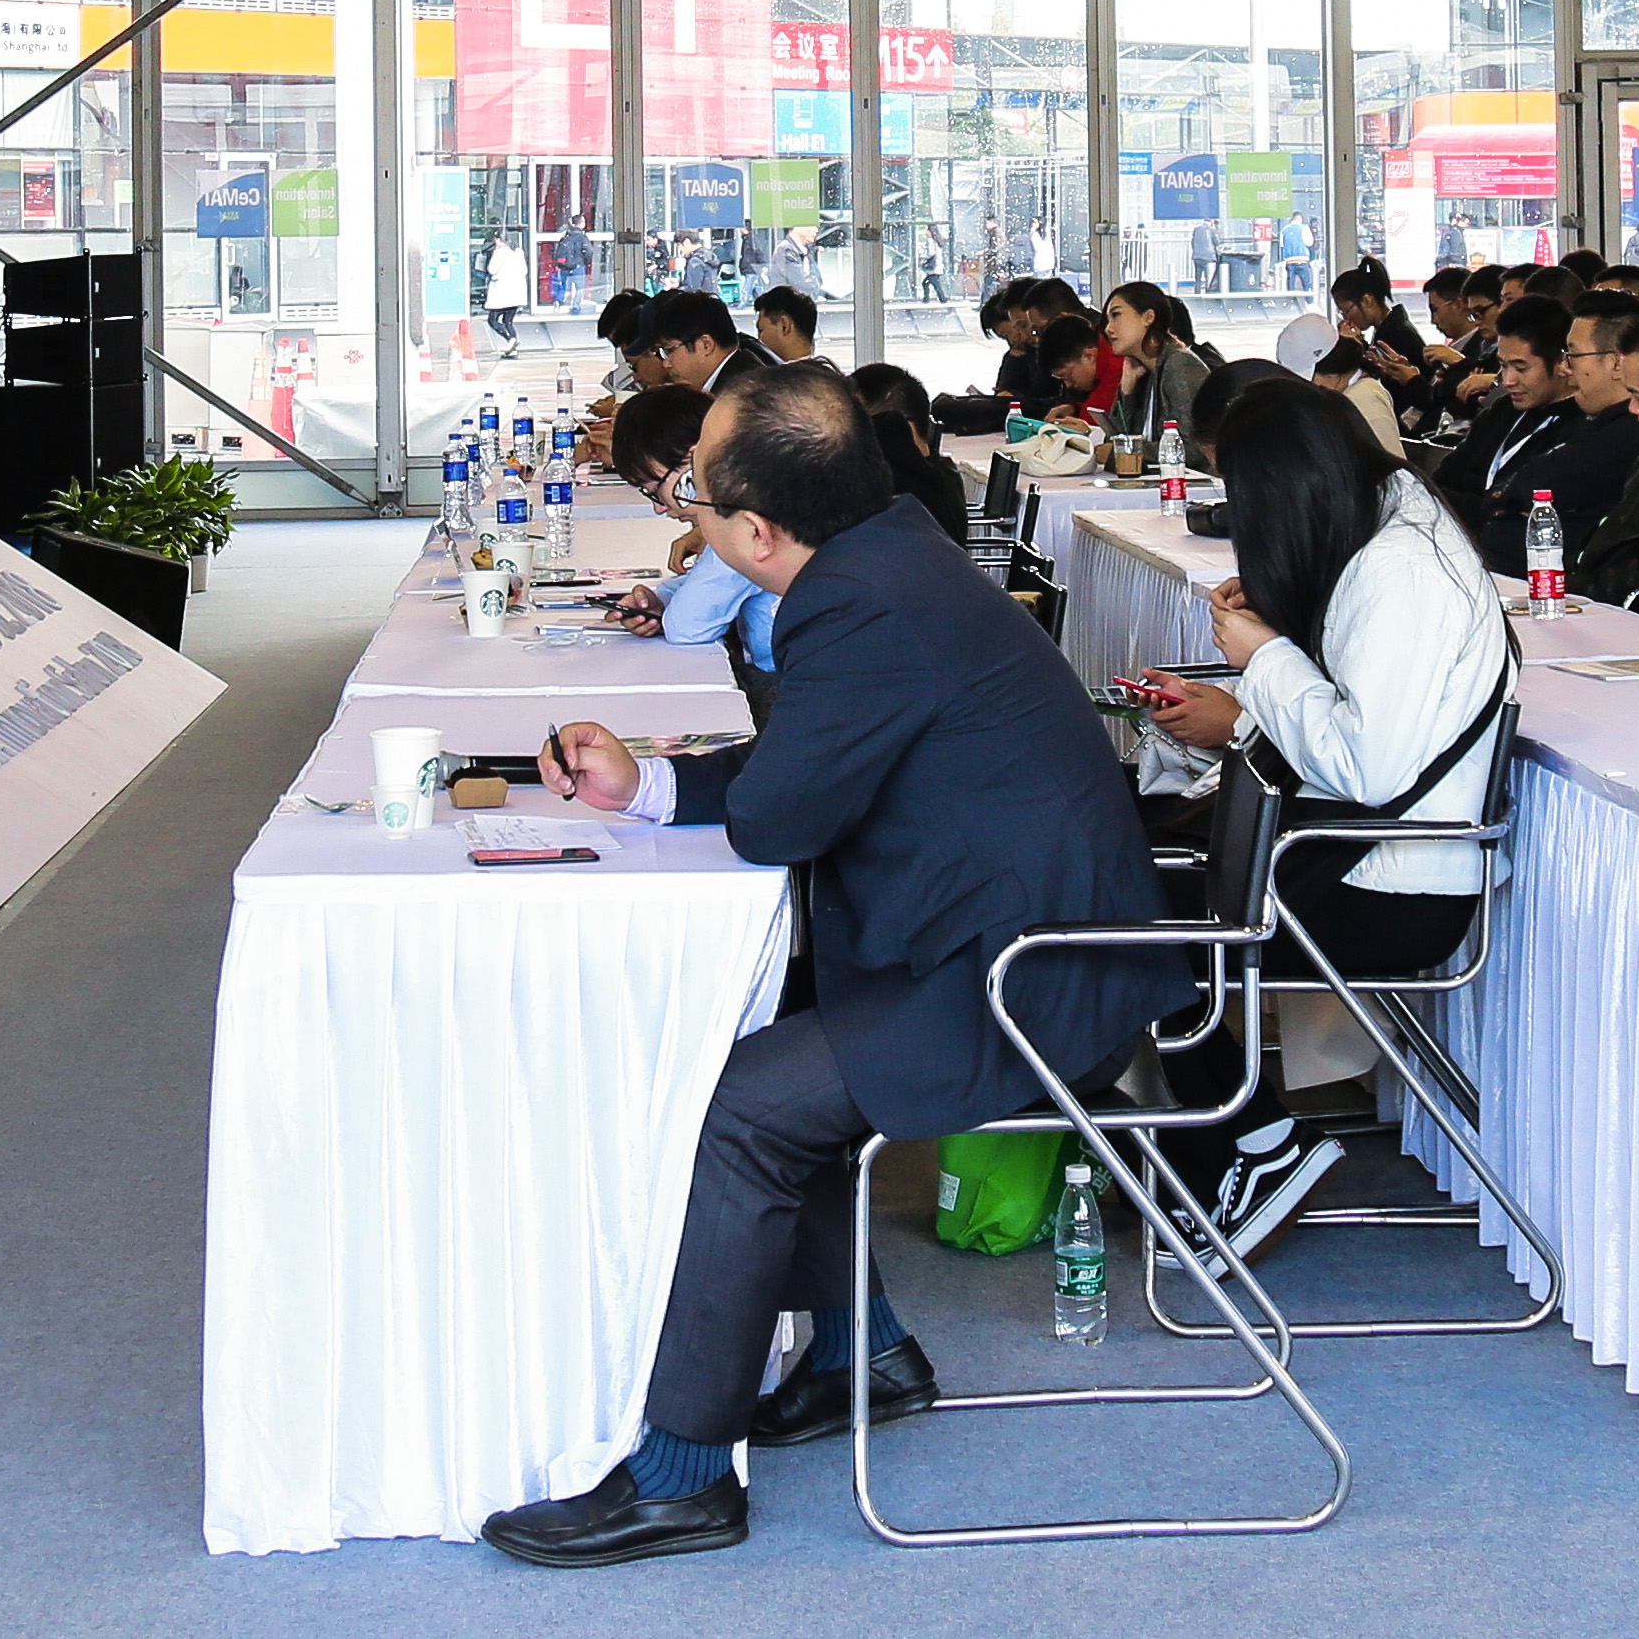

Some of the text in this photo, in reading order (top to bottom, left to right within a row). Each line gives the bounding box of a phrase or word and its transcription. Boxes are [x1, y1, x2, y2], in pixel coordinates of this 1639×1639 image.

[772, 31, 839, 61] 会议室
[772, 63, 820, 83] Meeting
[781, 133, 809, 151] Hall
